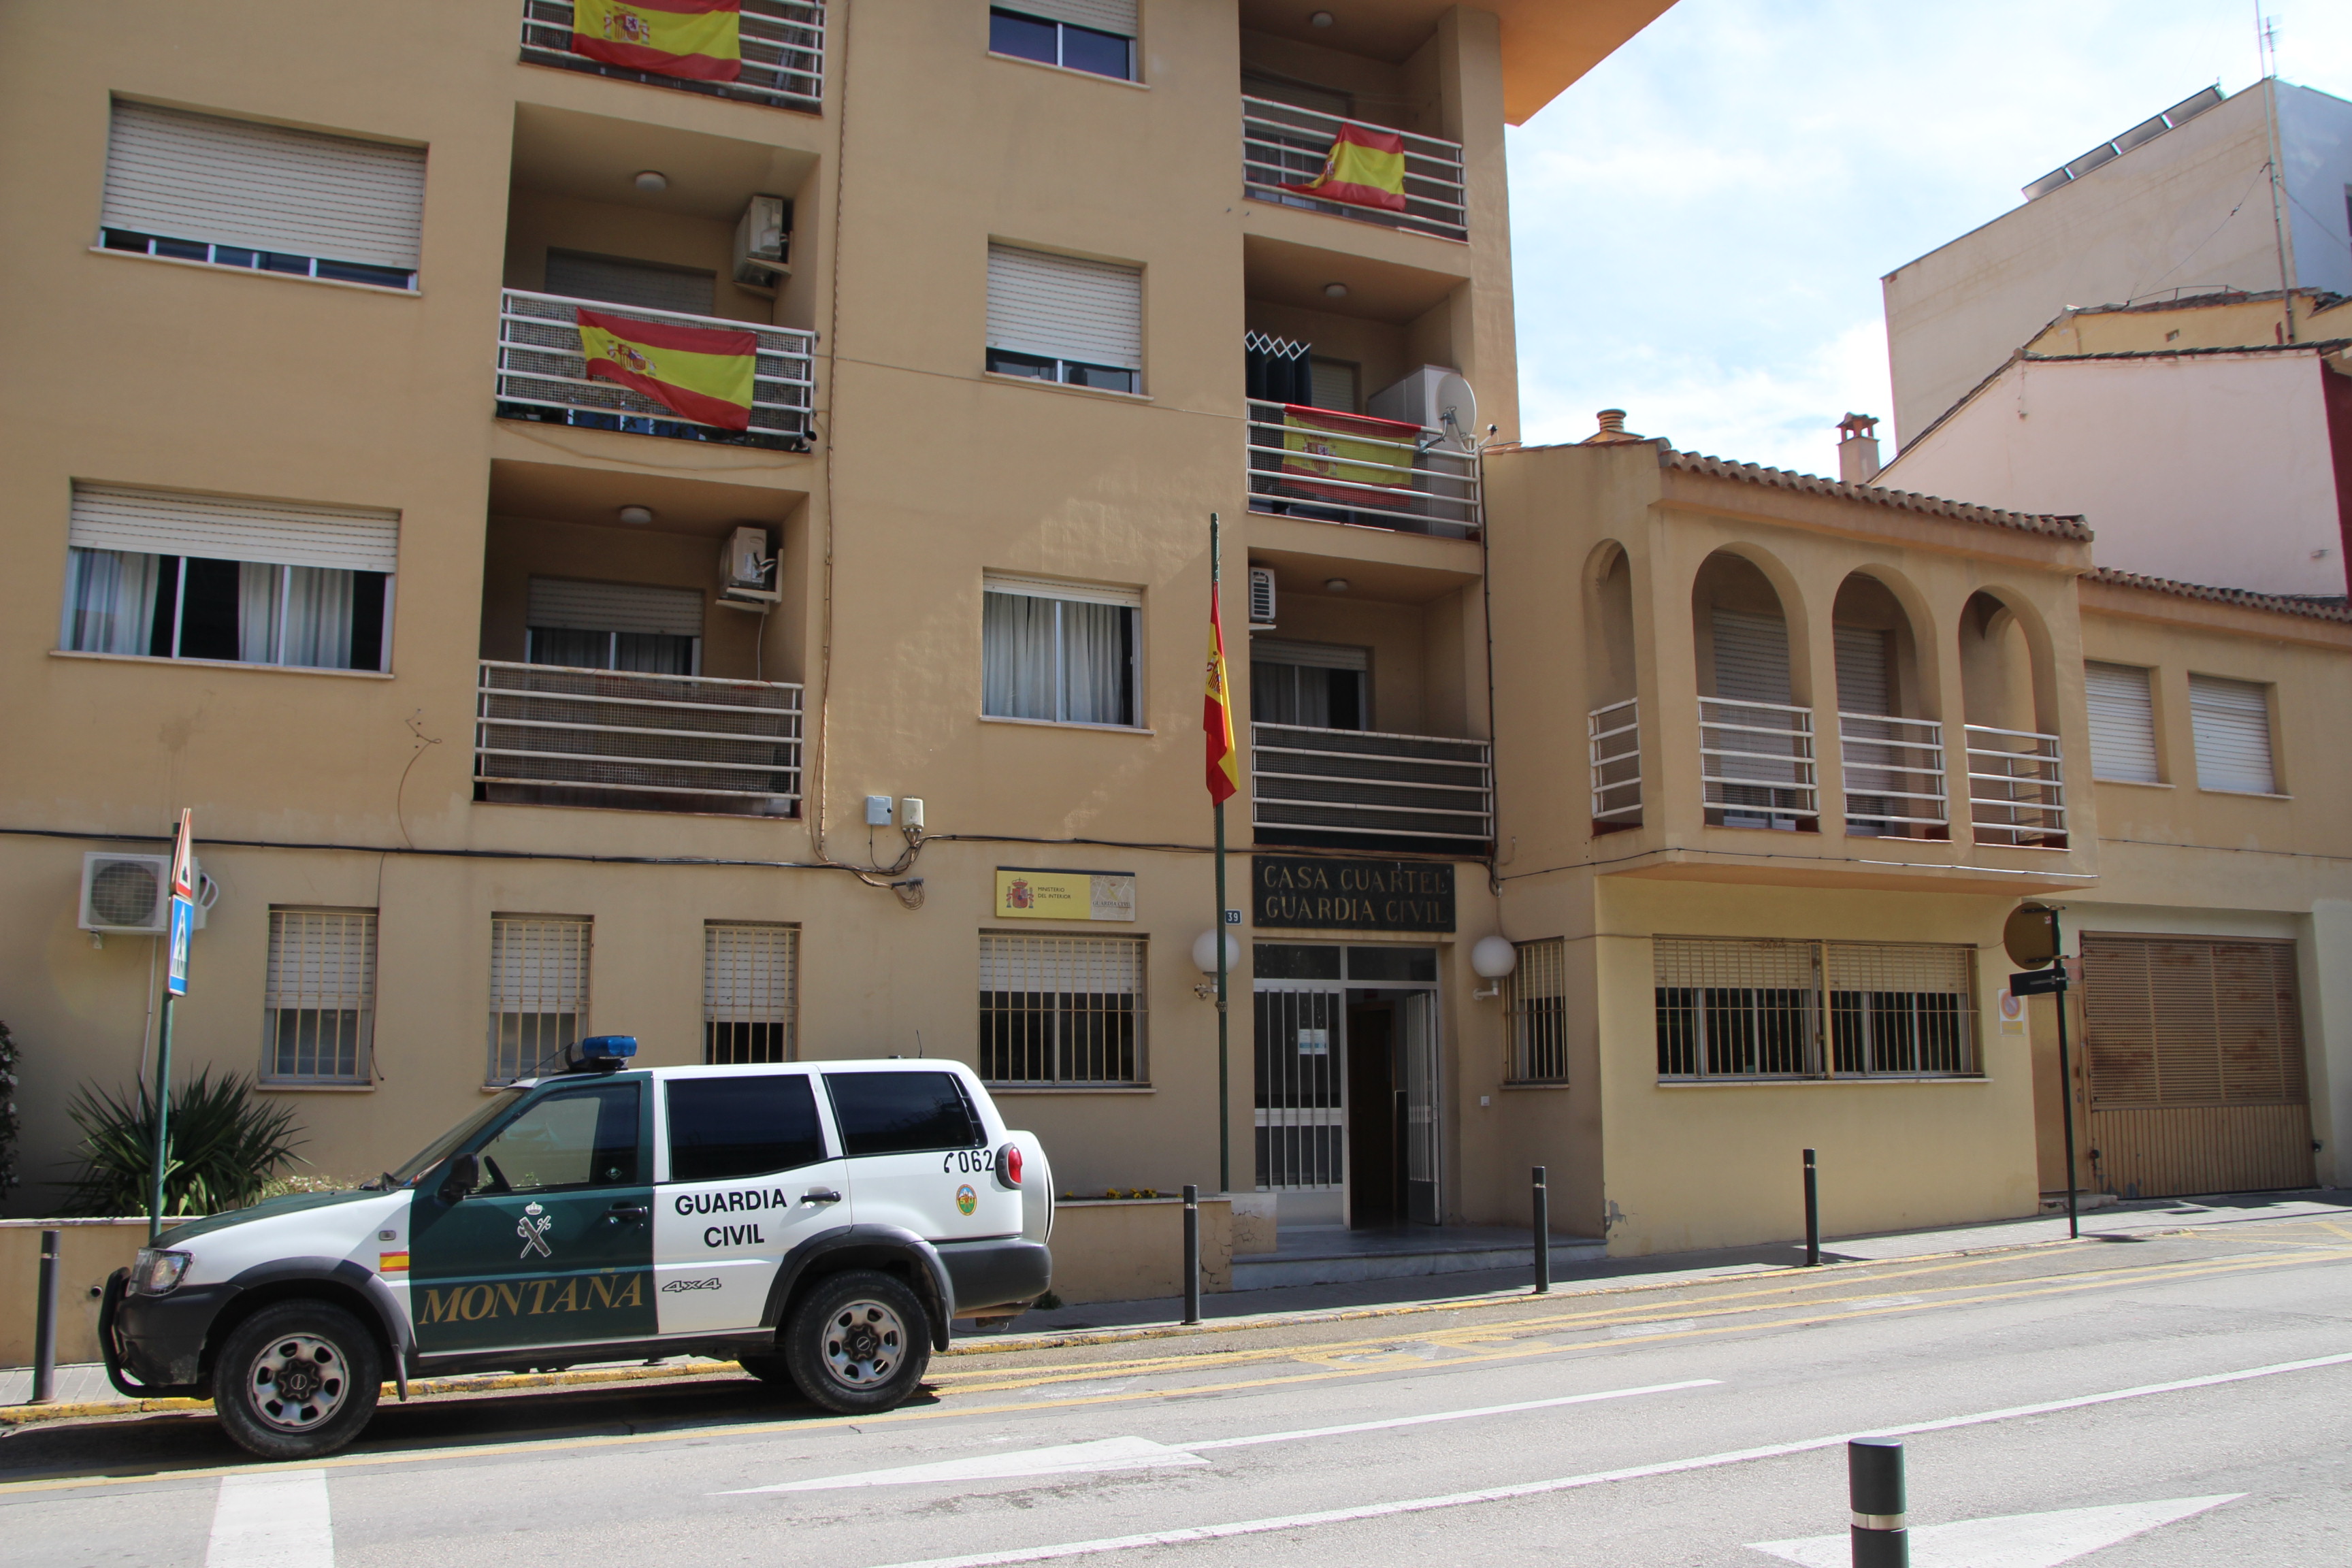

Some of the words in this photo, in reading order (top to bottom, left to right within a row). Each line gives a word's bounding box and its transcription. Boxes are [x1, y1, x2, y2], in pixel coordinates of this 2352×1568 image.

[1264, 866, 1329, 889] CASA
[1340, 869, 1448, 894] CUARTEL
[1227, 912, 1239, 922] 39
[1265, 896, 1375, 921] GUARDIA
[1386, 900, 1448, 924] CIVIL
[958, 1149, 994, 1173] 062
[675, 1188, 787, 1215] GUARDIA
[704, 1224, 765, 1248] CIVIL
[418, 1267, 643, 1325] MONTAÑA
[662, 1277, 722, 1293] 4x4
